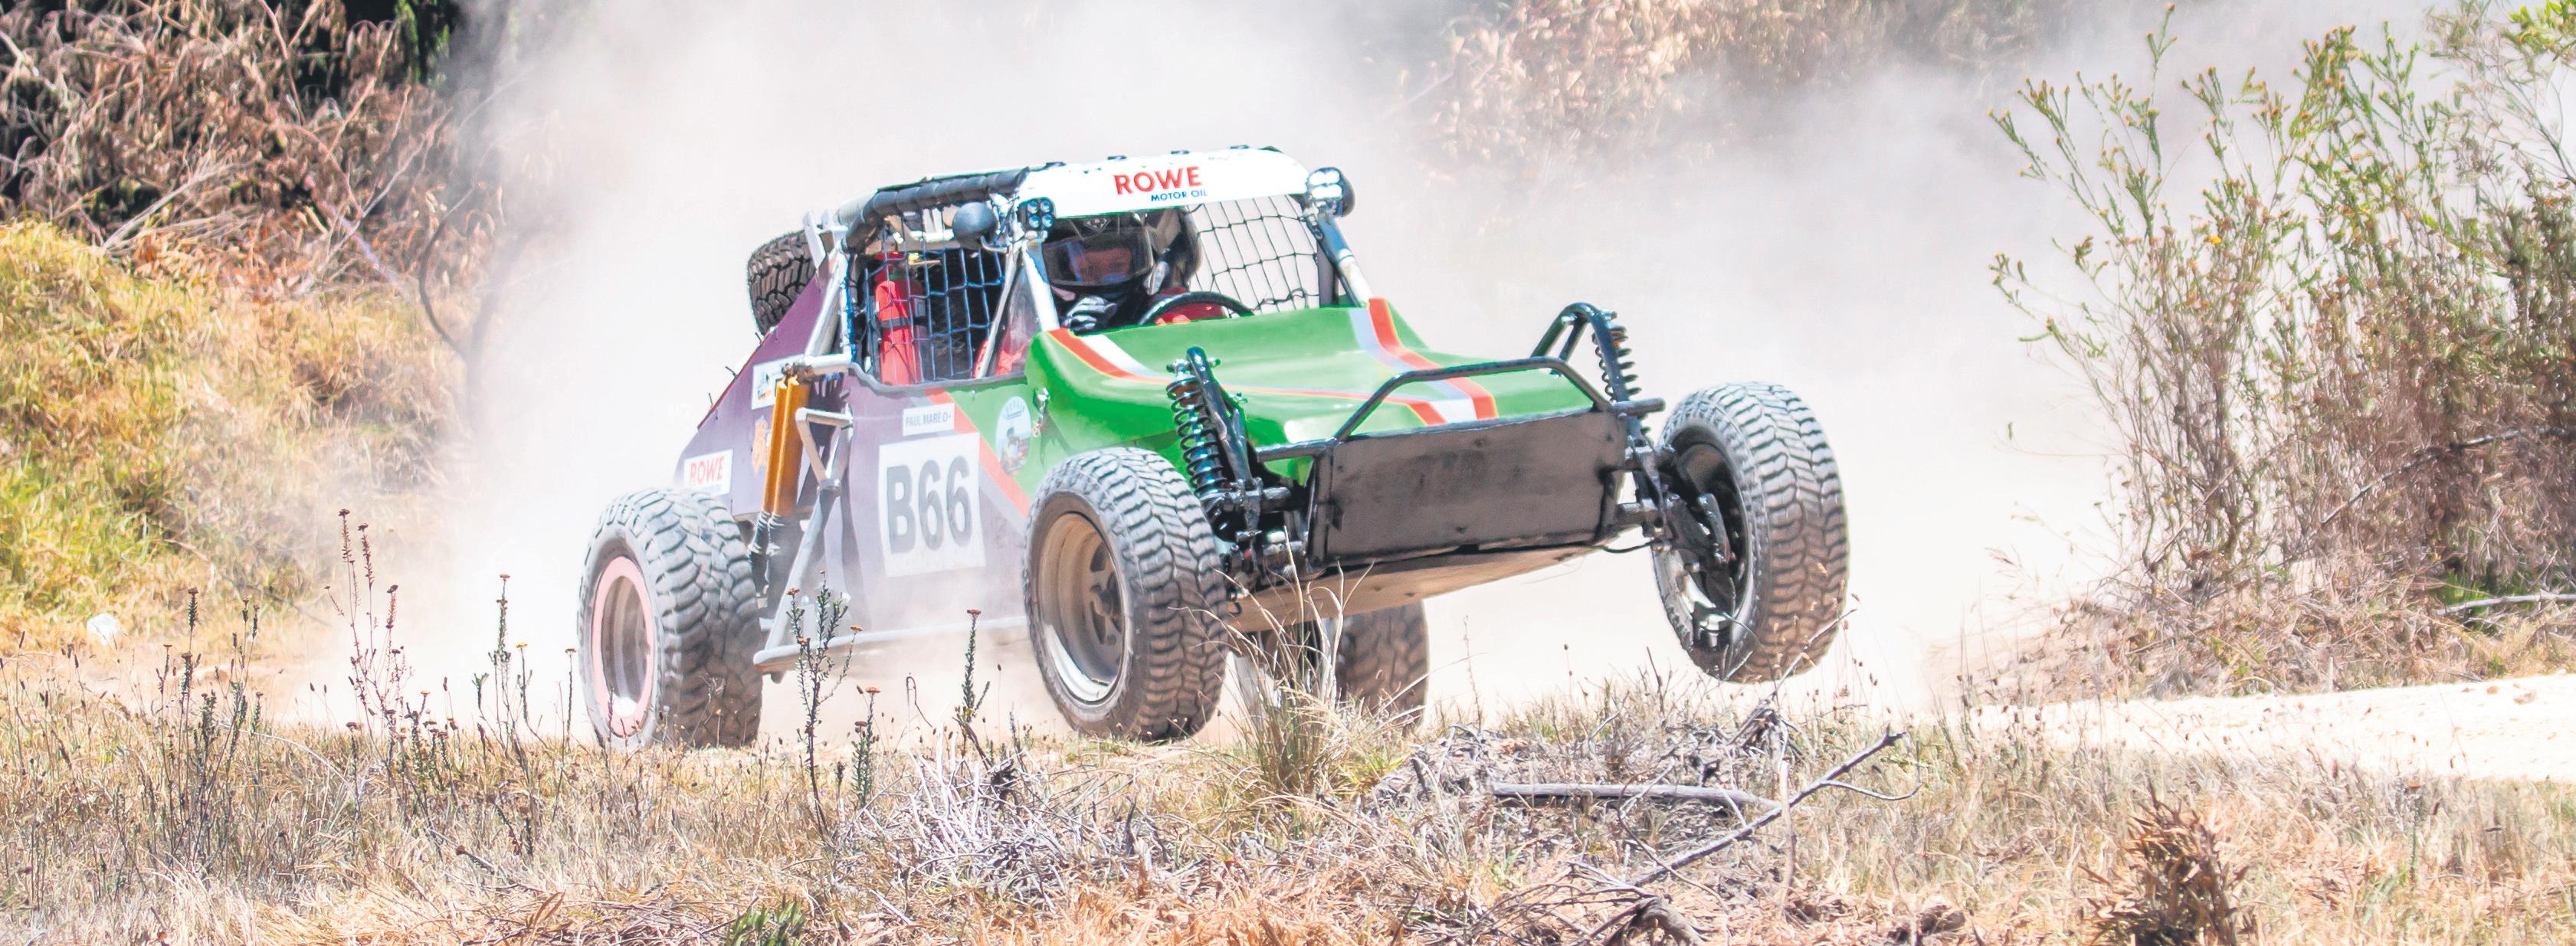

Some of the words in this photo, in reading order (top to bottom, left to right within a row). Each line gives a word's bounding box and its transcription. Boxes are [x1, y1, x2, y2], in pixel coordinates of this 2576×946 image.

[1113, 166, 1202, 195] ROWE
[1151, 191, 1187, 201] MOTOR
[1191, 189, 1208, 198] OIL
[690, 456, 725, 485] ROWE
[887, 456, 972, 555] B66
